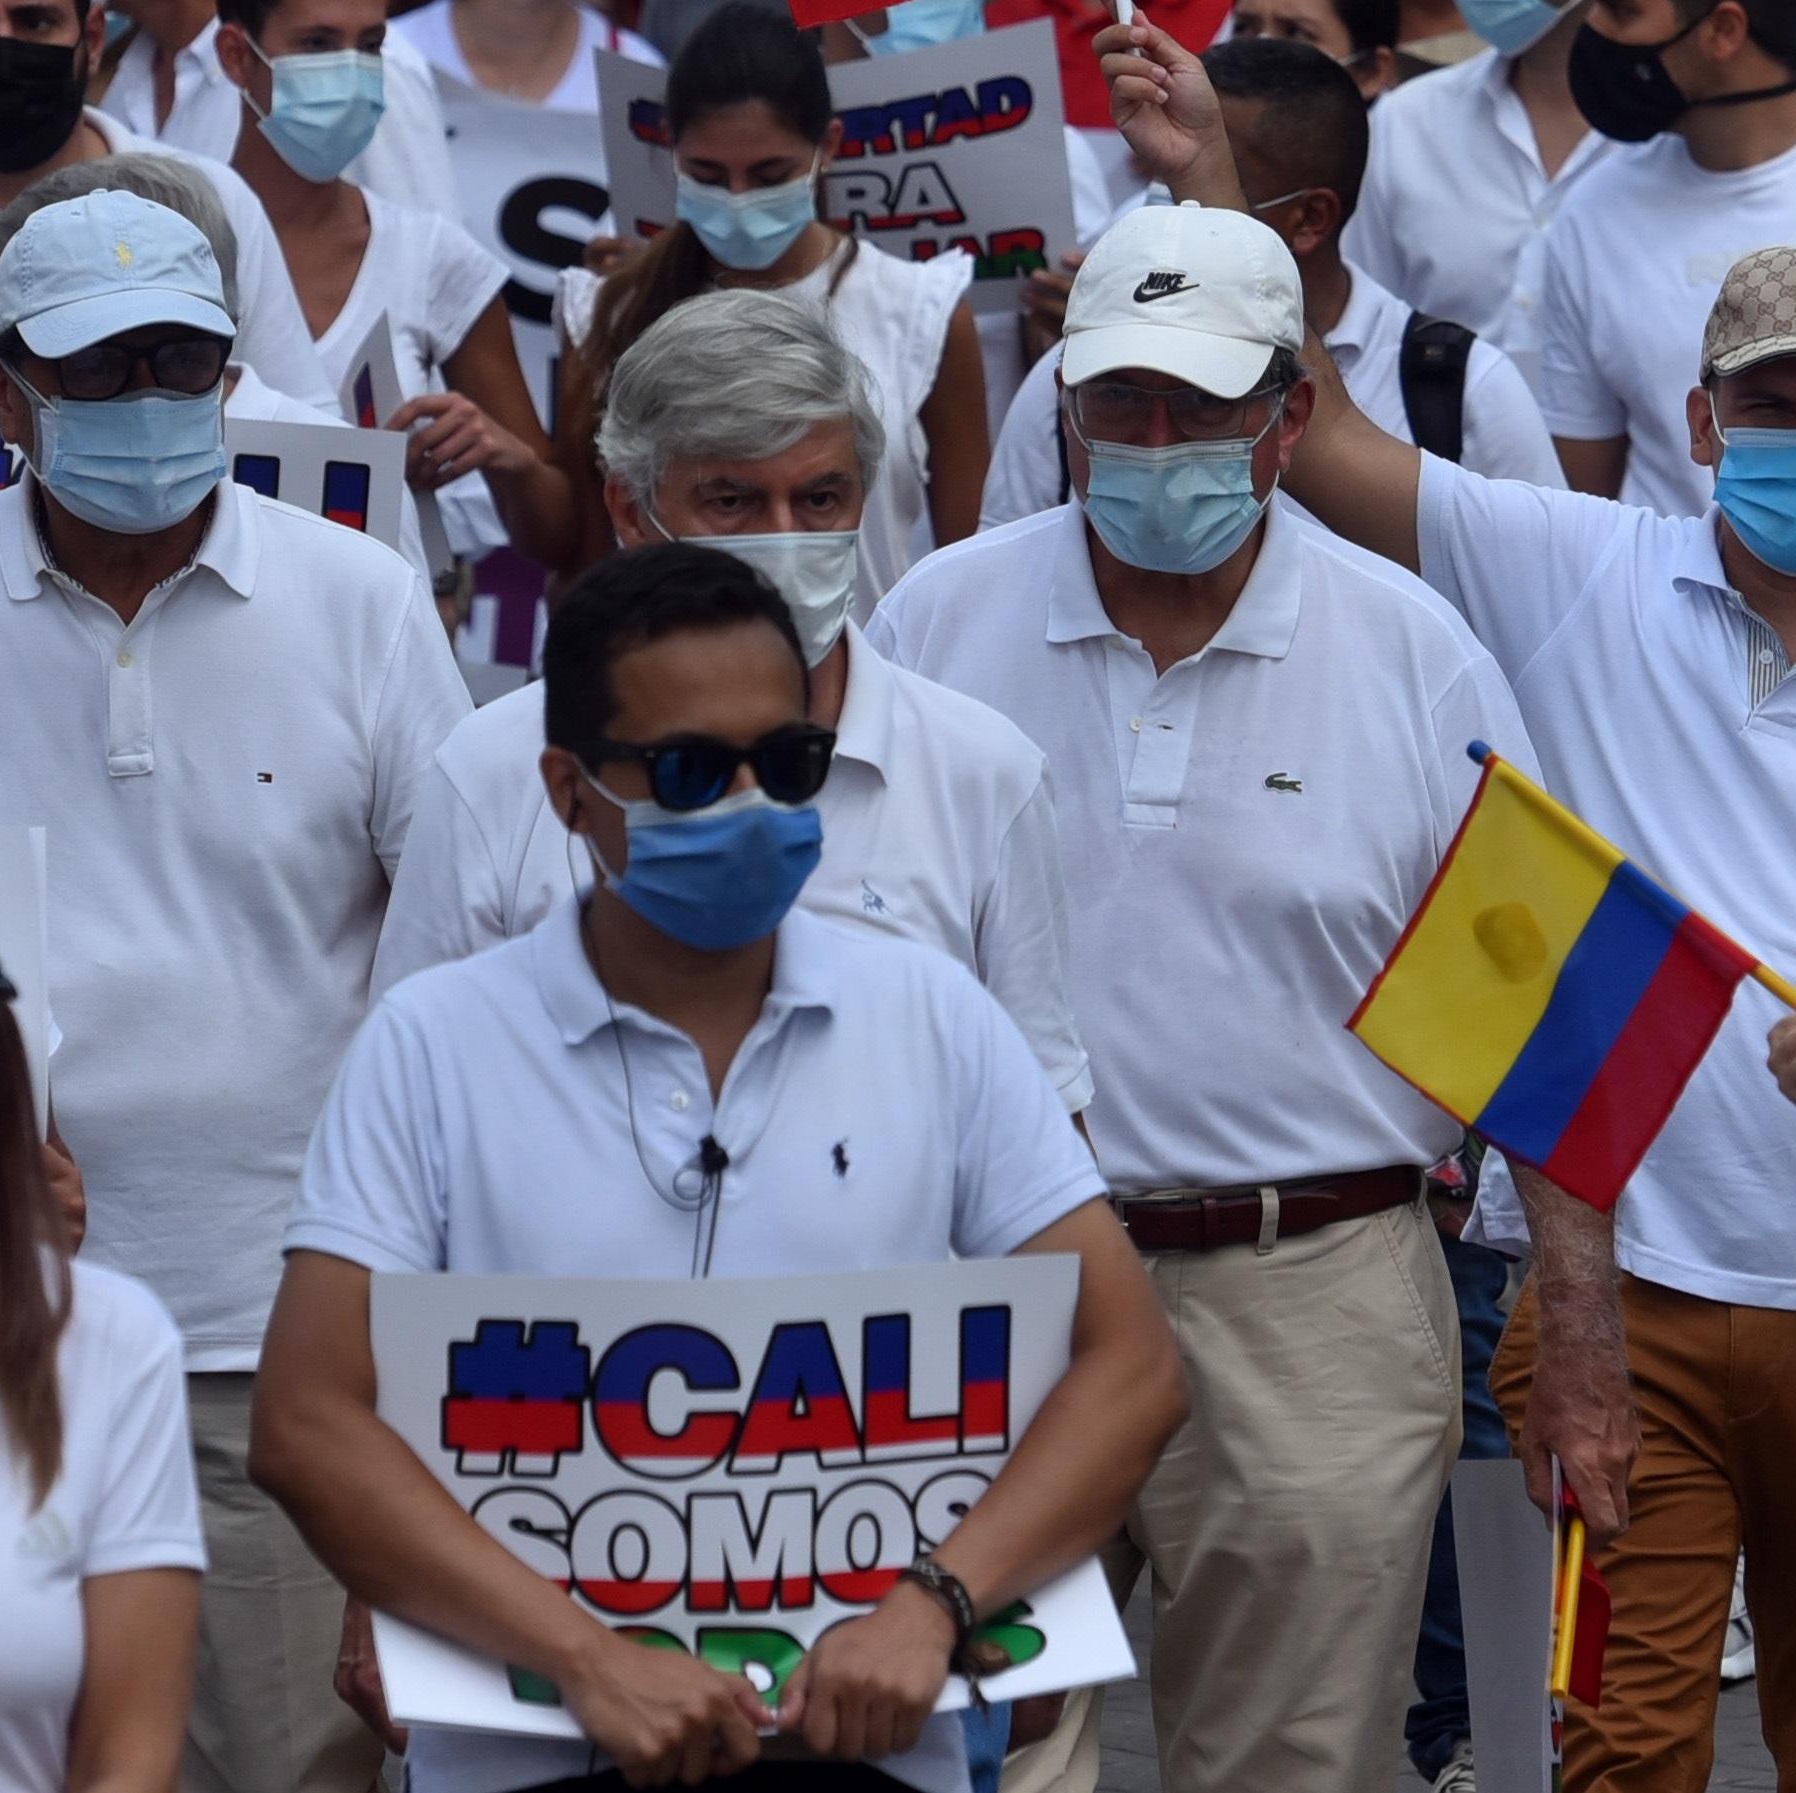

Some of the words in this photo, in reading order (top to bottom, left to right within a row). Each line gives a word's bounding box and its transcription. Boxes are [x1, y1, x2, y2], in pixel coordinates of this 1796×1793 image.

[822, 160, 967, 233] RA
[1143, 271, 1186, 291] NIKE
[440, 1303, 1012, 1479] #CALI
